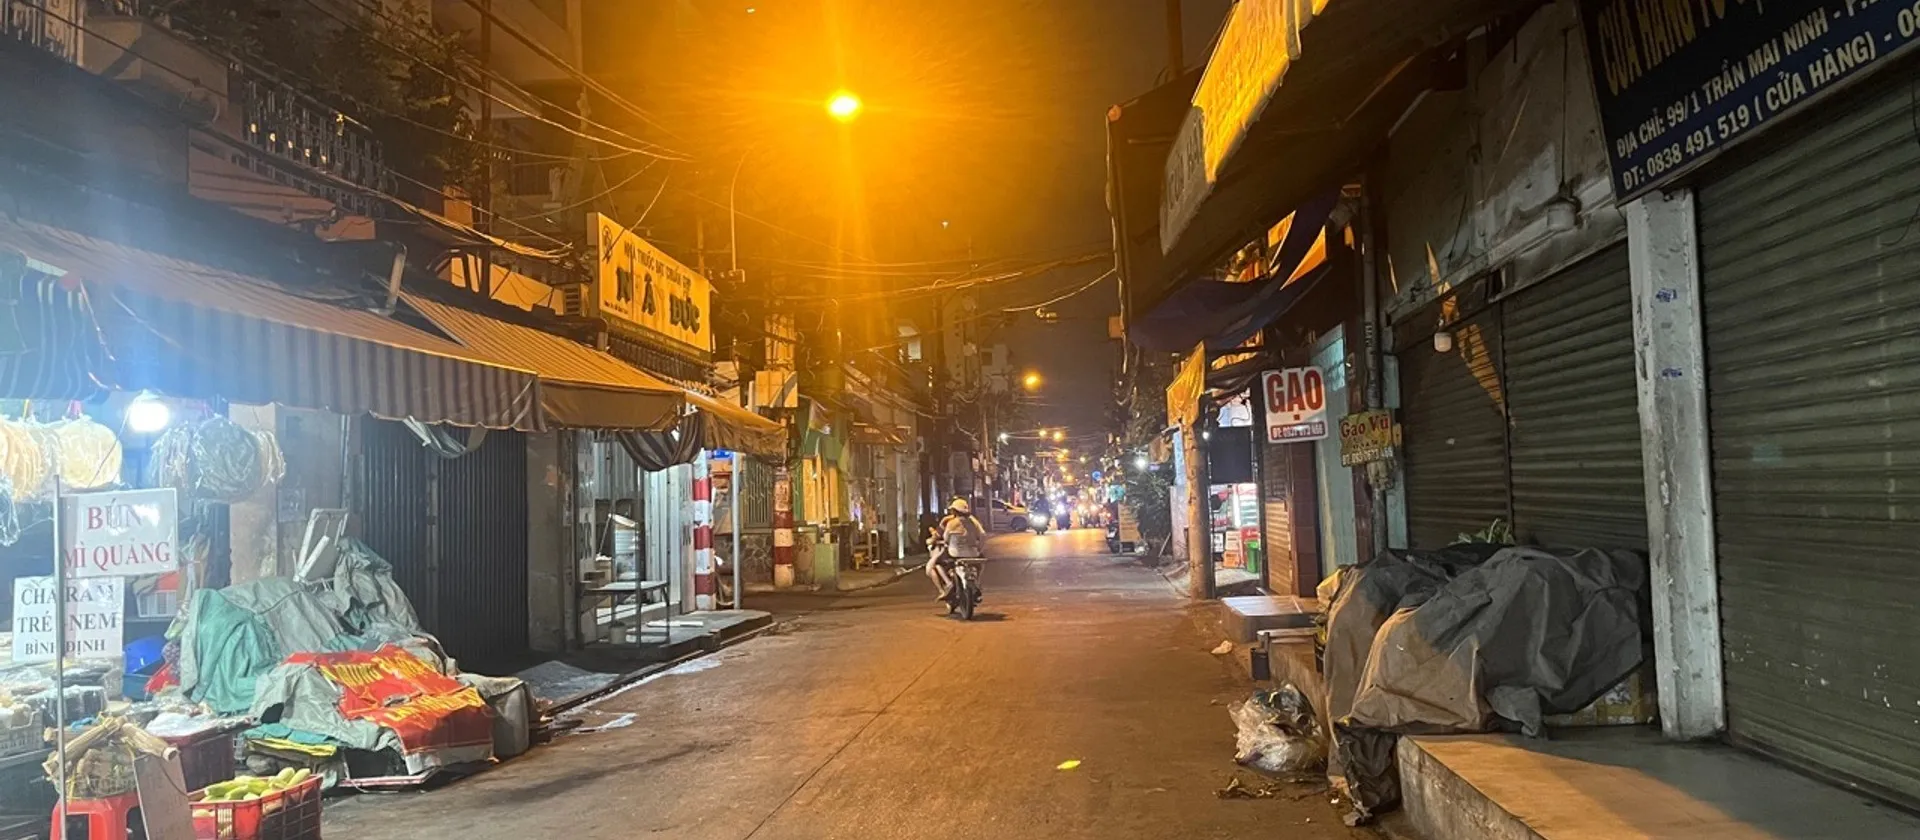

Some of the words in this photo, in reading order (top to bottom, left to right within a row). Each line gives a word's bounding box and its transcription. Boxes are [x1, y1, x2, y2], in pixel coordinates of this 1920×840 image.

[1616, 131, 1638, 159] ĐỊA
[1666, 91, 1702, 128] 99/1
[1702, 59, 1746, 105] TRẦN
[1747, 38, 1781, 79] MAI
[1782, 7, 1829, 56] NINH
[1622, 166, 1646, 191] ĐT:
[1646, 143, 1683, 178] 0838
[1685, 125, 1715, 156] 491
[1717, 104, 1751, 139] 519
[1765, 71, 1807, 111] CỬA
[1808, 31, 1876, 88] HÀNG)
[1266, 369, 1323, 421] GẠO
[87, 498, 142, 530] BÚN
[93, 537, 170, 571] QUẢNG
[65, 638, 106, 656] ĐỊNH
